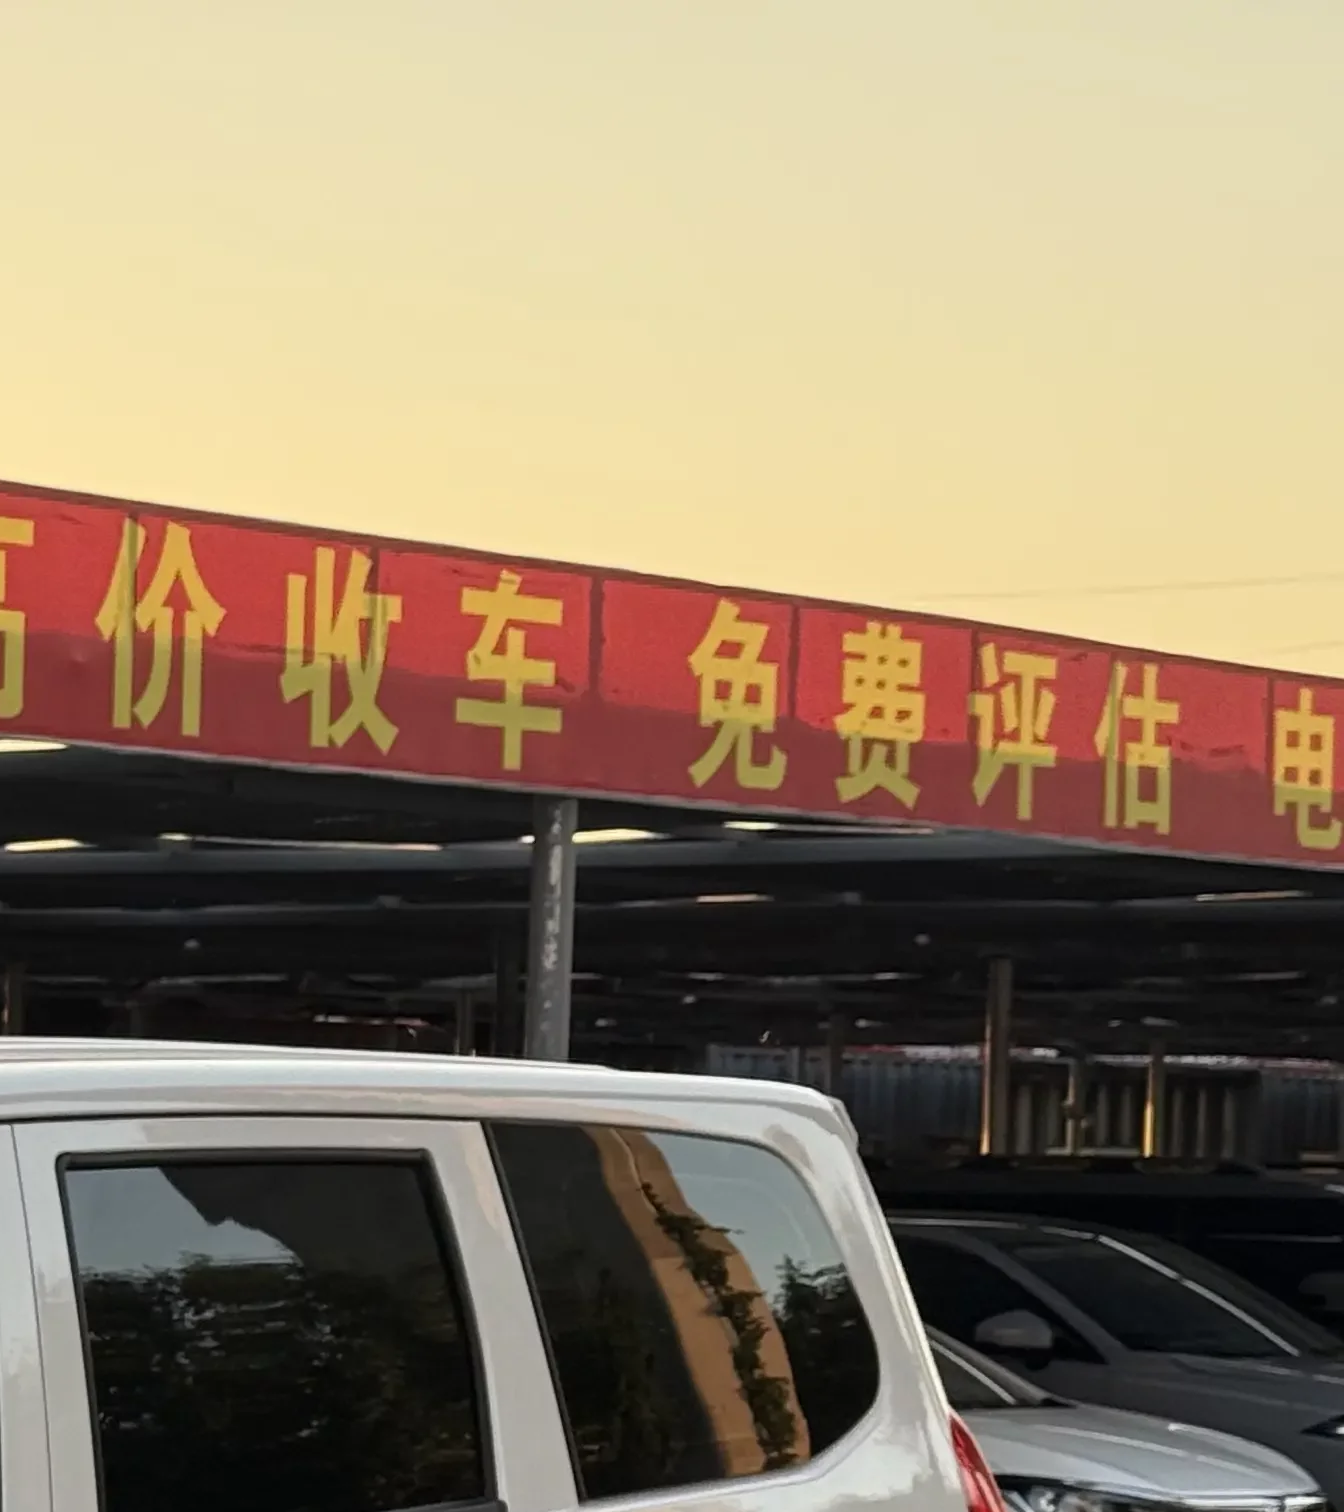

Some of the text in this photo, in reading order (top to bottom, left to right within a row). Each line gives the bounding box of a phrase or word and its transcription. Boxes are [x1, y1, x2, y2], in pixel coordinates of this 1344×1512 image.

[688, 597, 1179, 835] 免费评估
[1273, 687, 1343, 850] 电
